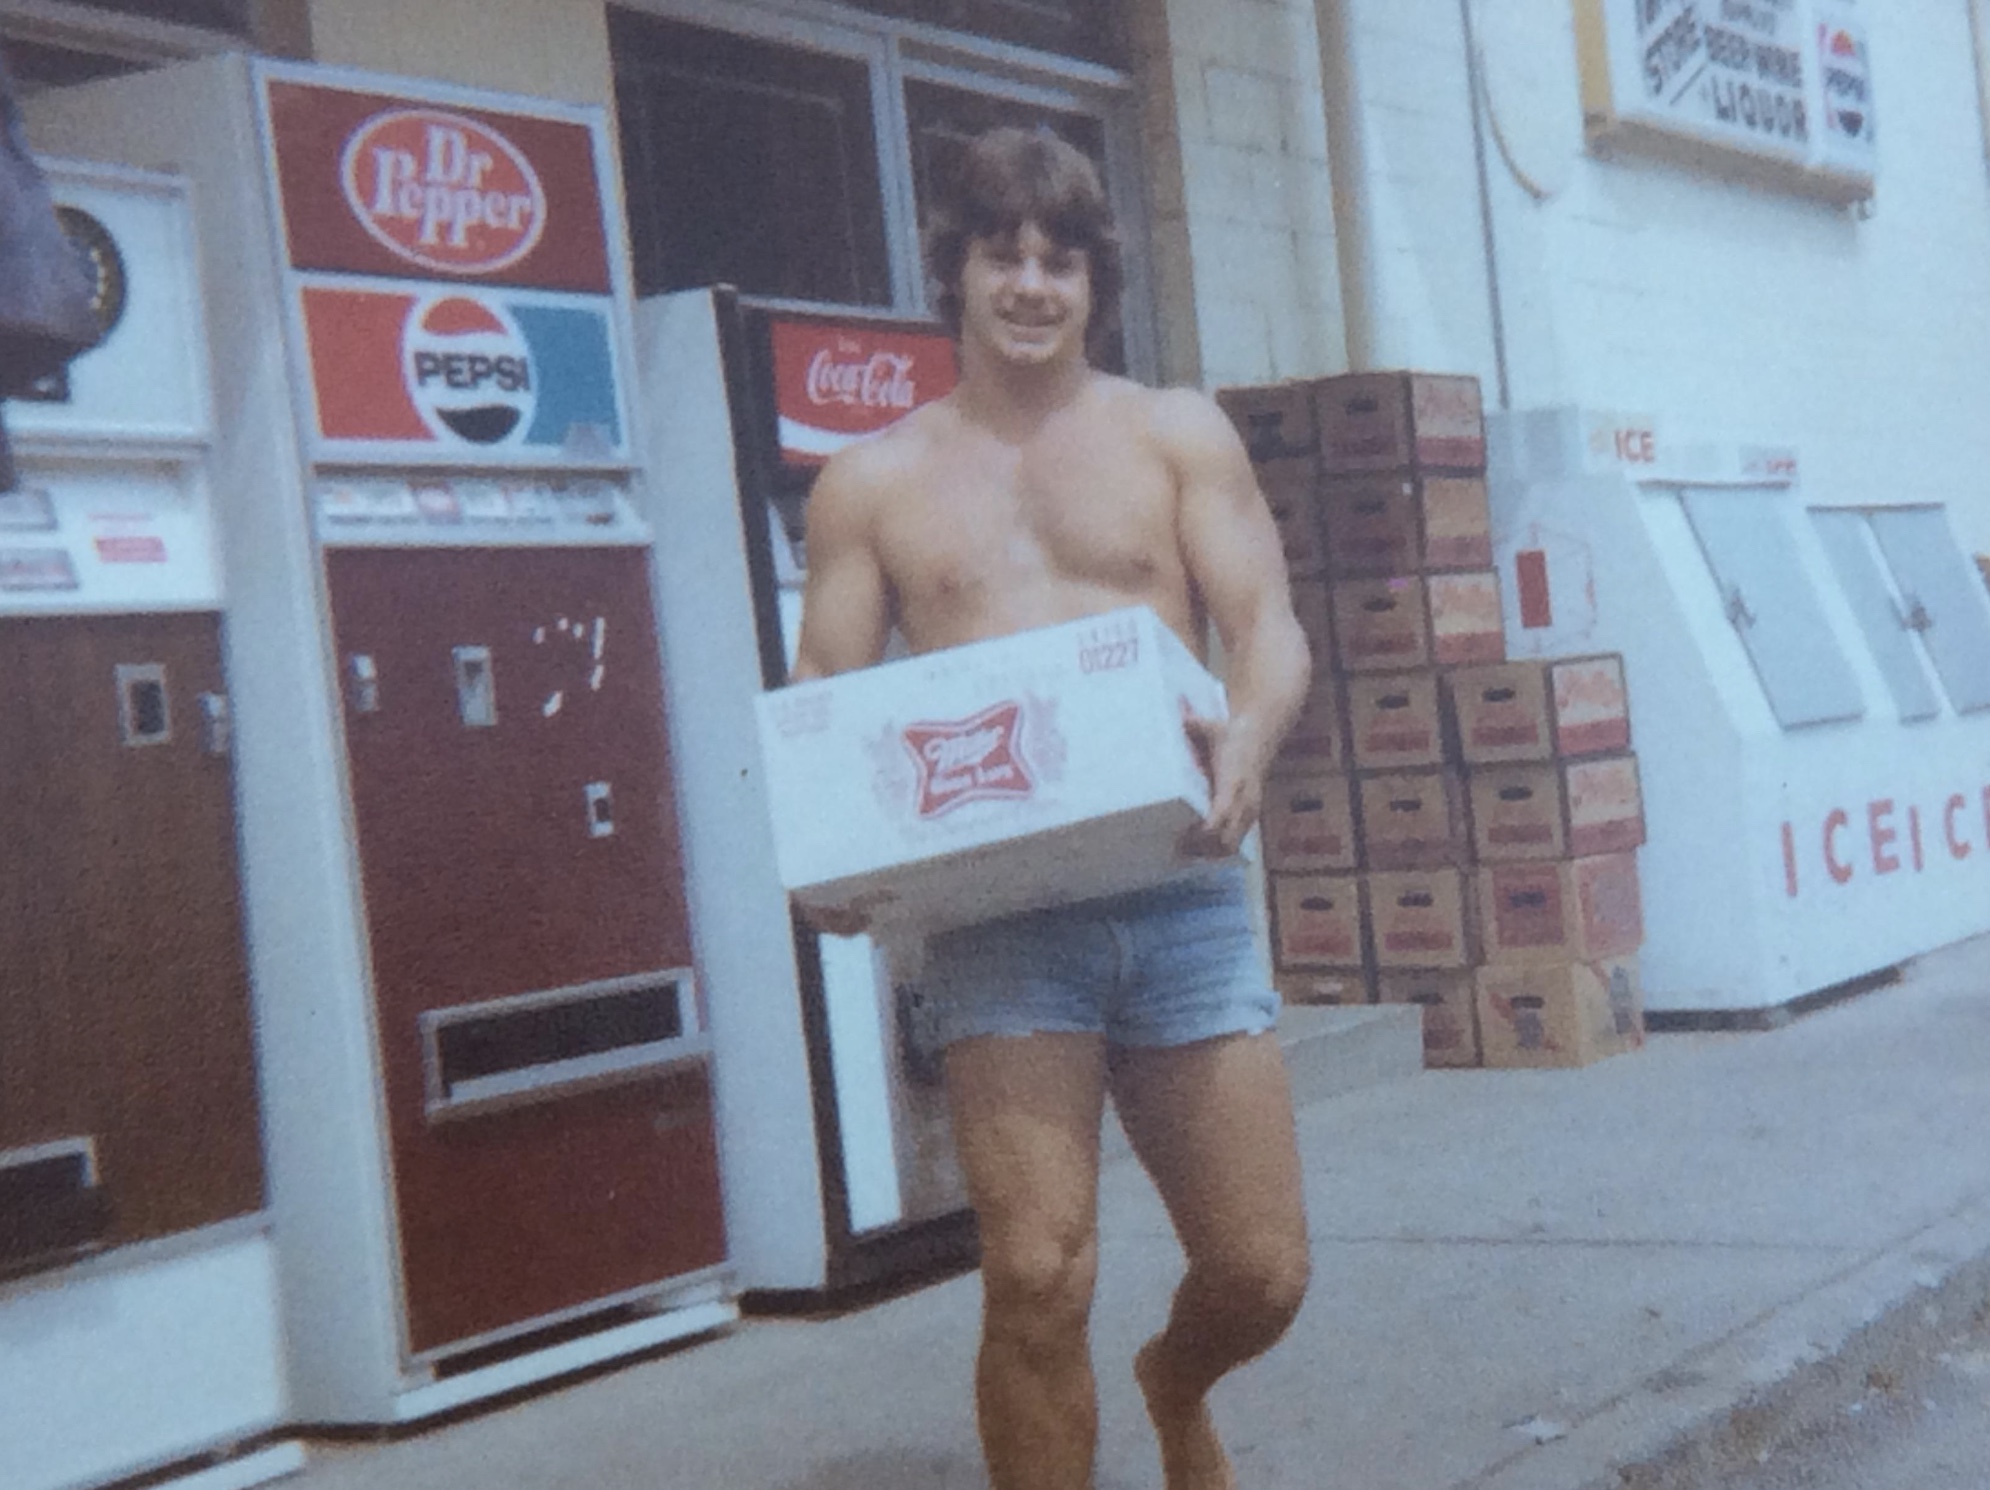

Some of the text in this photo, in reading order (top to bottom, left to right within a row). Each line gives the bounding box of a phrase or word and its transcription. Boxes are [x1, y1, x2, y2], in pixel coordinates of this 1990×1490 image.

[1711, 74, 1808, 143] LIQUOR
[425, 123, 493, 190] Dr
[373, 146, 532, 247] Pepper
[414, 351, 531, 392] PEPSI
[1615, 428, 1655, 463] ICE
